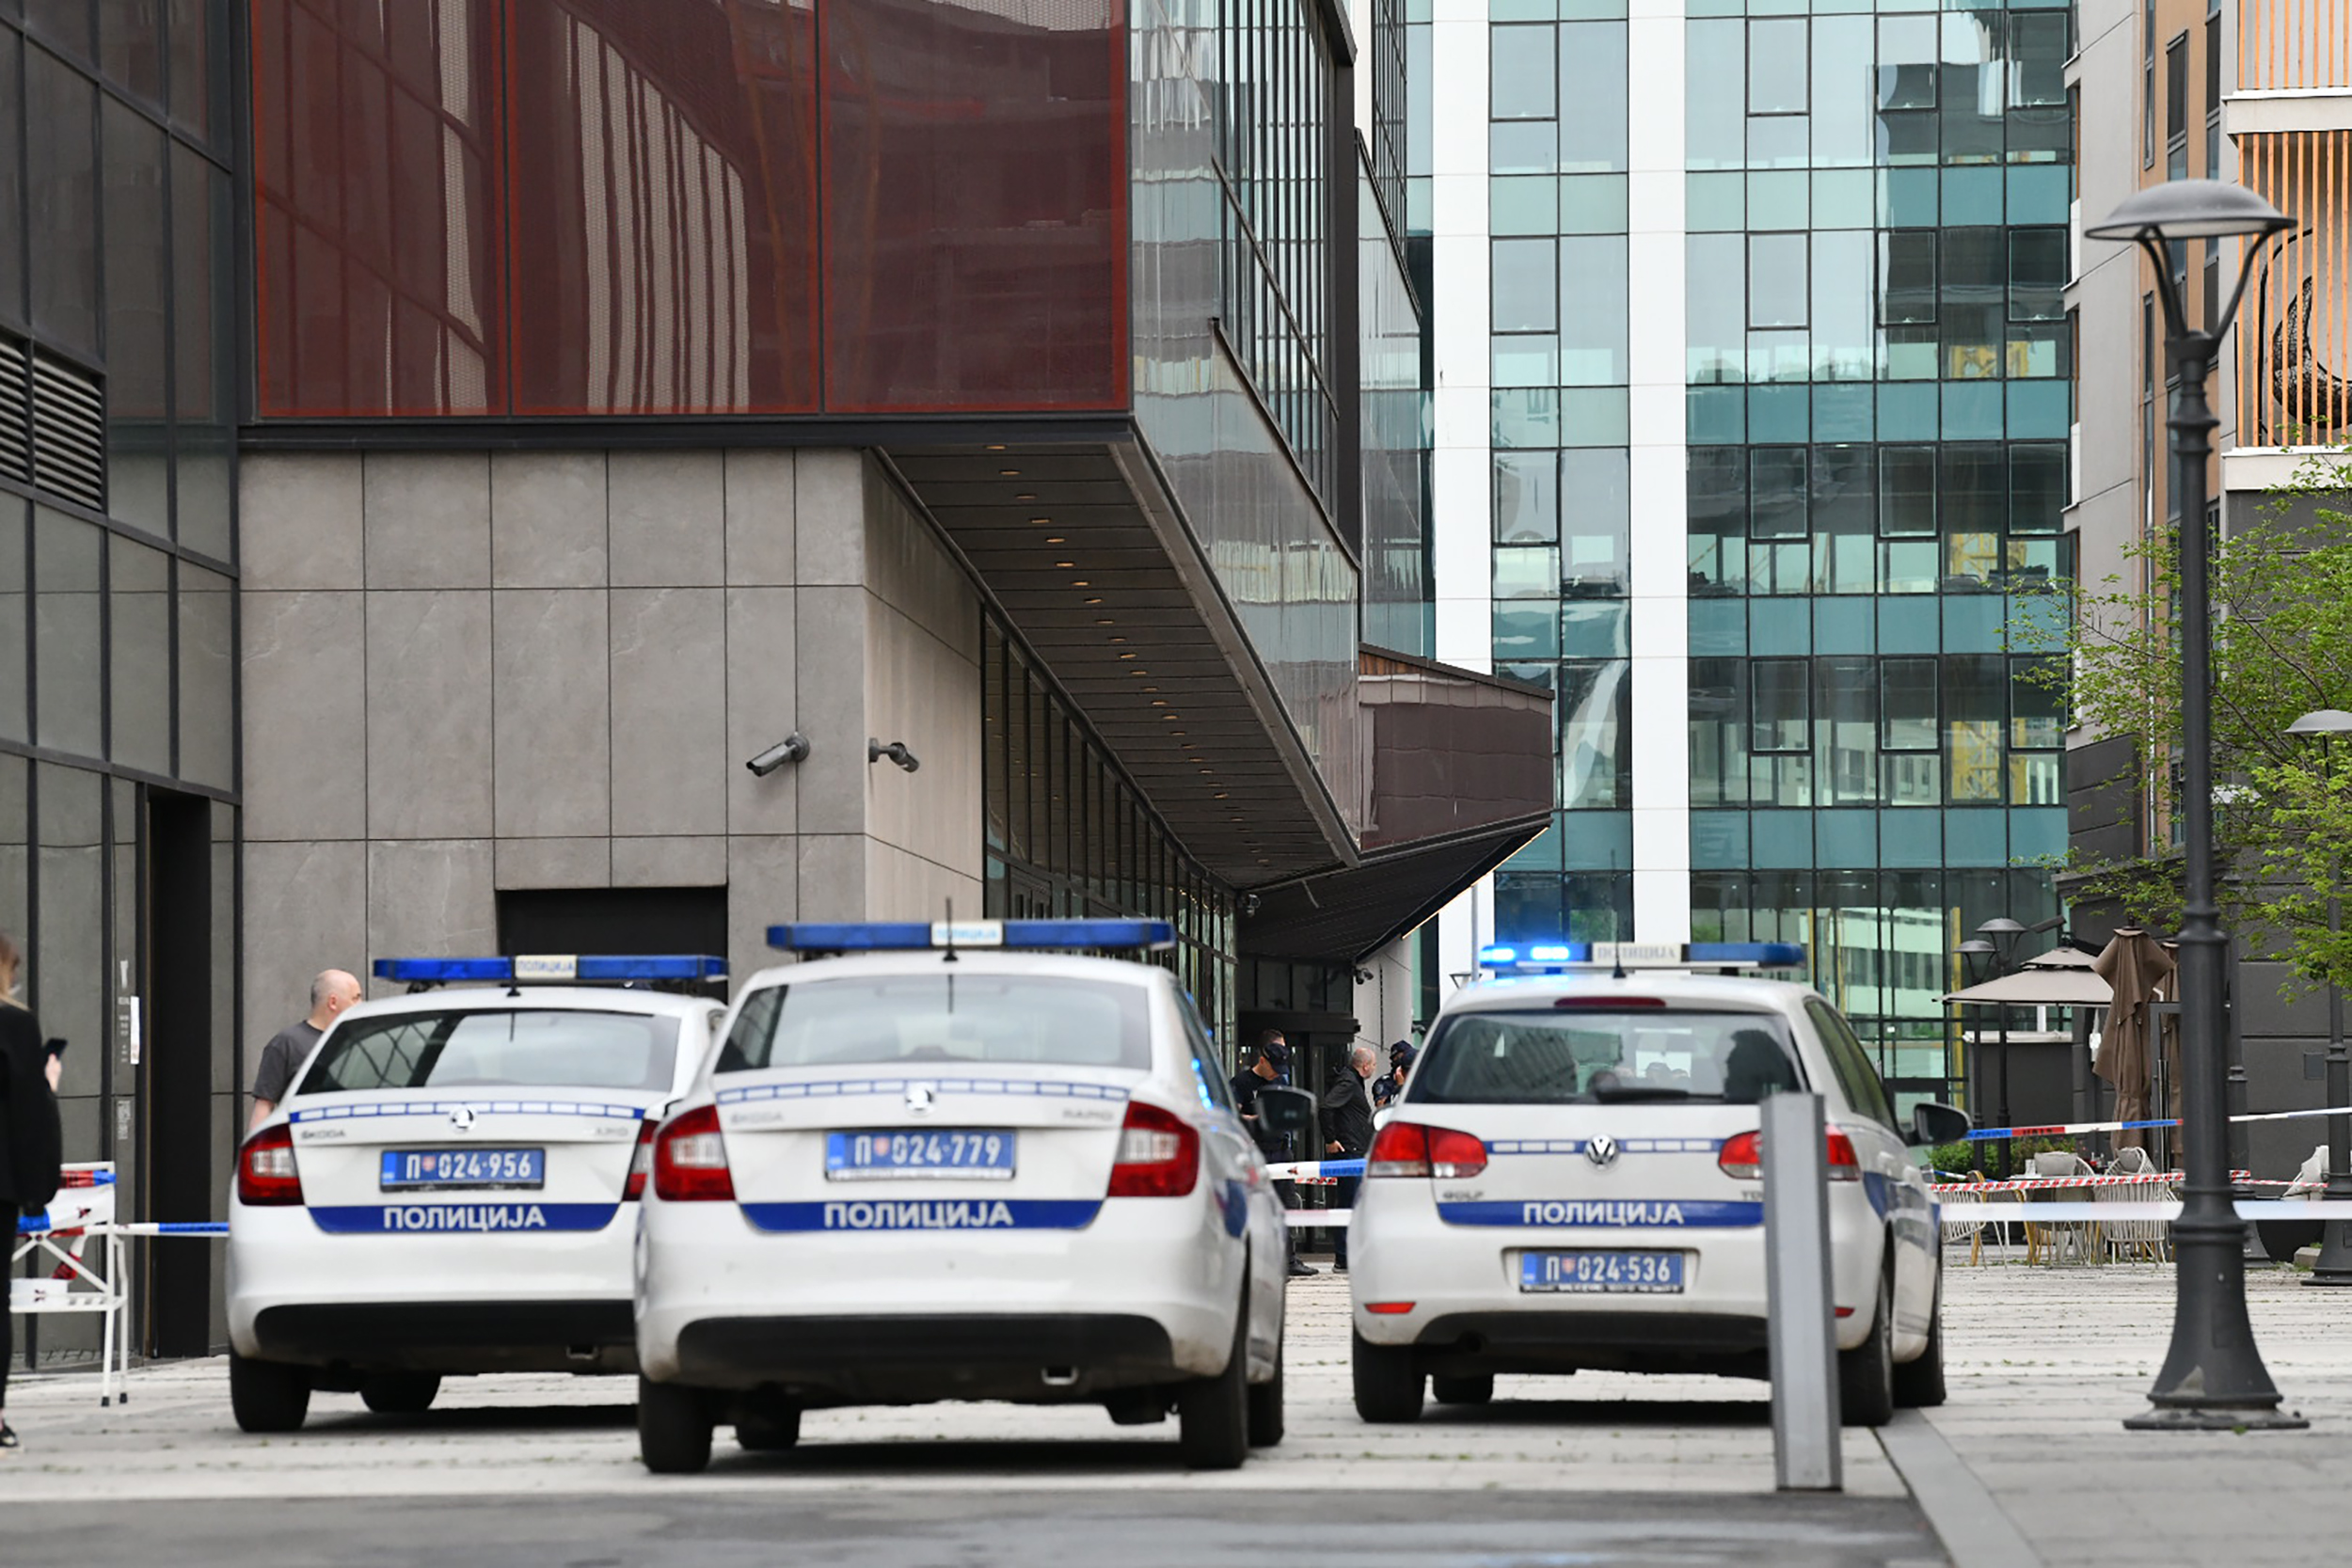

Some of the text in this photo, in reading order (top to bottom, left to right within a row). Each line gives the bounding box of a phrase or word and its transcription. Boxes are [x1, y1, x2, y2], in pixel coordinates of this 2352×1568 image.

[853, 1136, 871, 1165] П
[405, 1153, 421, 1180] П
[383, 1206, 547, 1231] ПОЛИЦИЈА
[824, 1201, 1014, 1229] ПОЛИЦИЈА
[1523, 1202, 1685, 1227] ПОЛИЦИЈА
[1546, 1256, 1560, 1282] П
